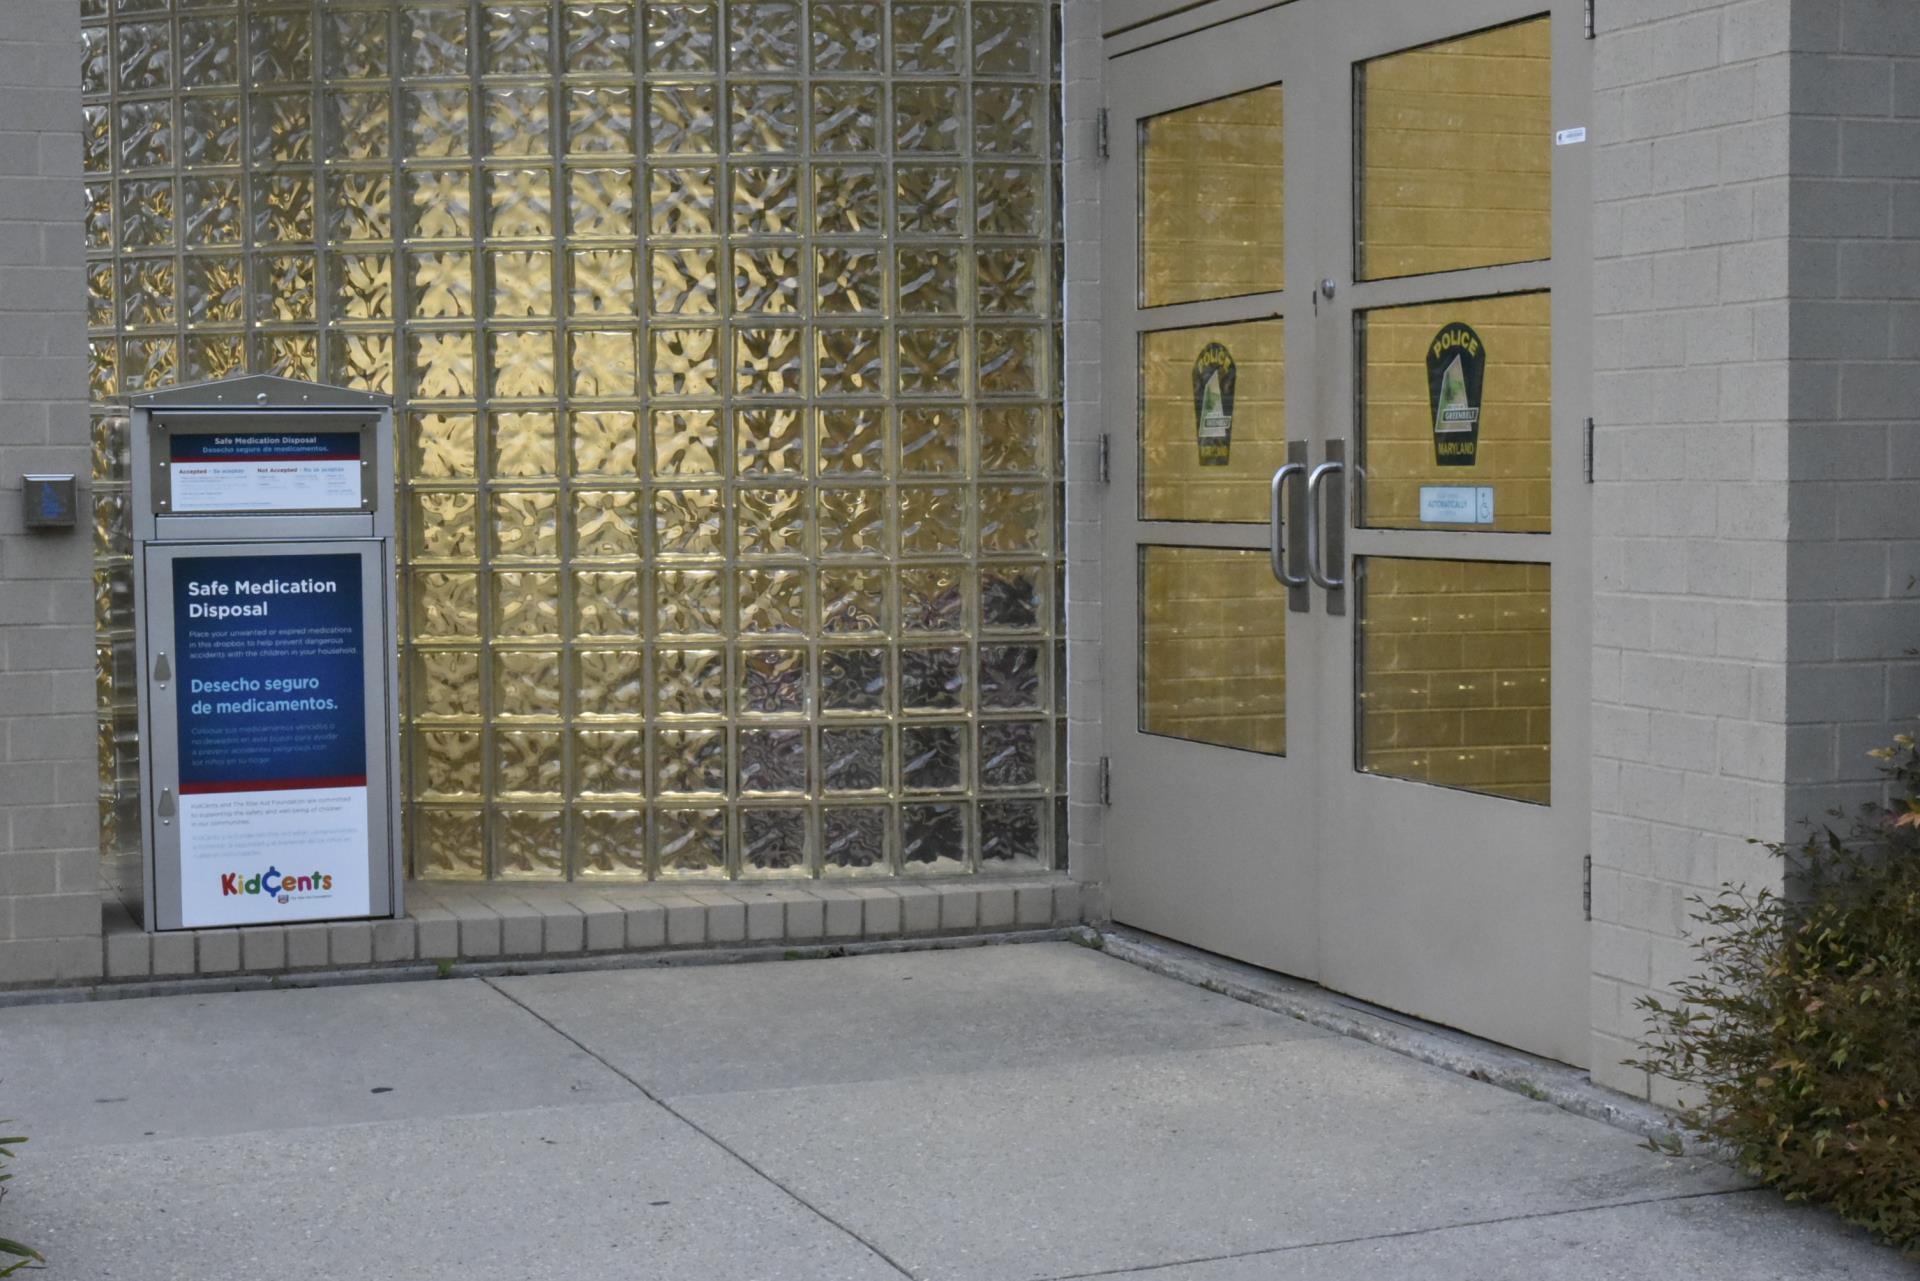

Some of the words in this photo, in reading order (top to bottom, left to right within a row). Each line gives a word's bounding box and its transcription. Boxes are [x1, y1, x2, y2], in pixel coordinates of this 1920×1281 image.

[1433, 330, 1479, 359] POLICE
[1444, 411, 1475, 421] GREENBELT
[214, 437, 232, 445] Safe
[235, 436, 280, 445] Medication
[282, 436, 317, 445] Disposal
[1438, 442, 1473, 456] MARYLAND
[188, 580, 229, 596] Safe
[235, 578, 337, 595] Medication
[188, 601, 268, 620] Disposal
[189, 630, 210, 638] Place
[278, 628, 306, 636] expired
[307, 626, 352, 634] medications
[198, 640, 212, 648] this
[213, 640, 245, 649] dropbox
[256, 639, 274, 648] help
[304, 637, 343, 646] dangerous
[190, 650, 225, 659] accidents
[245, 649, 258, 657] the
[259, 648, 289, 656] children
[299, 648, 316, 657] your
[191, 677, 260, 693] Desecho
[264, 677, 319, 693] seguro
[191, 700, 212, 715] de
[216, 697, 338, 714] medicamentos.
[221, 866, 332, 897] KidCents
